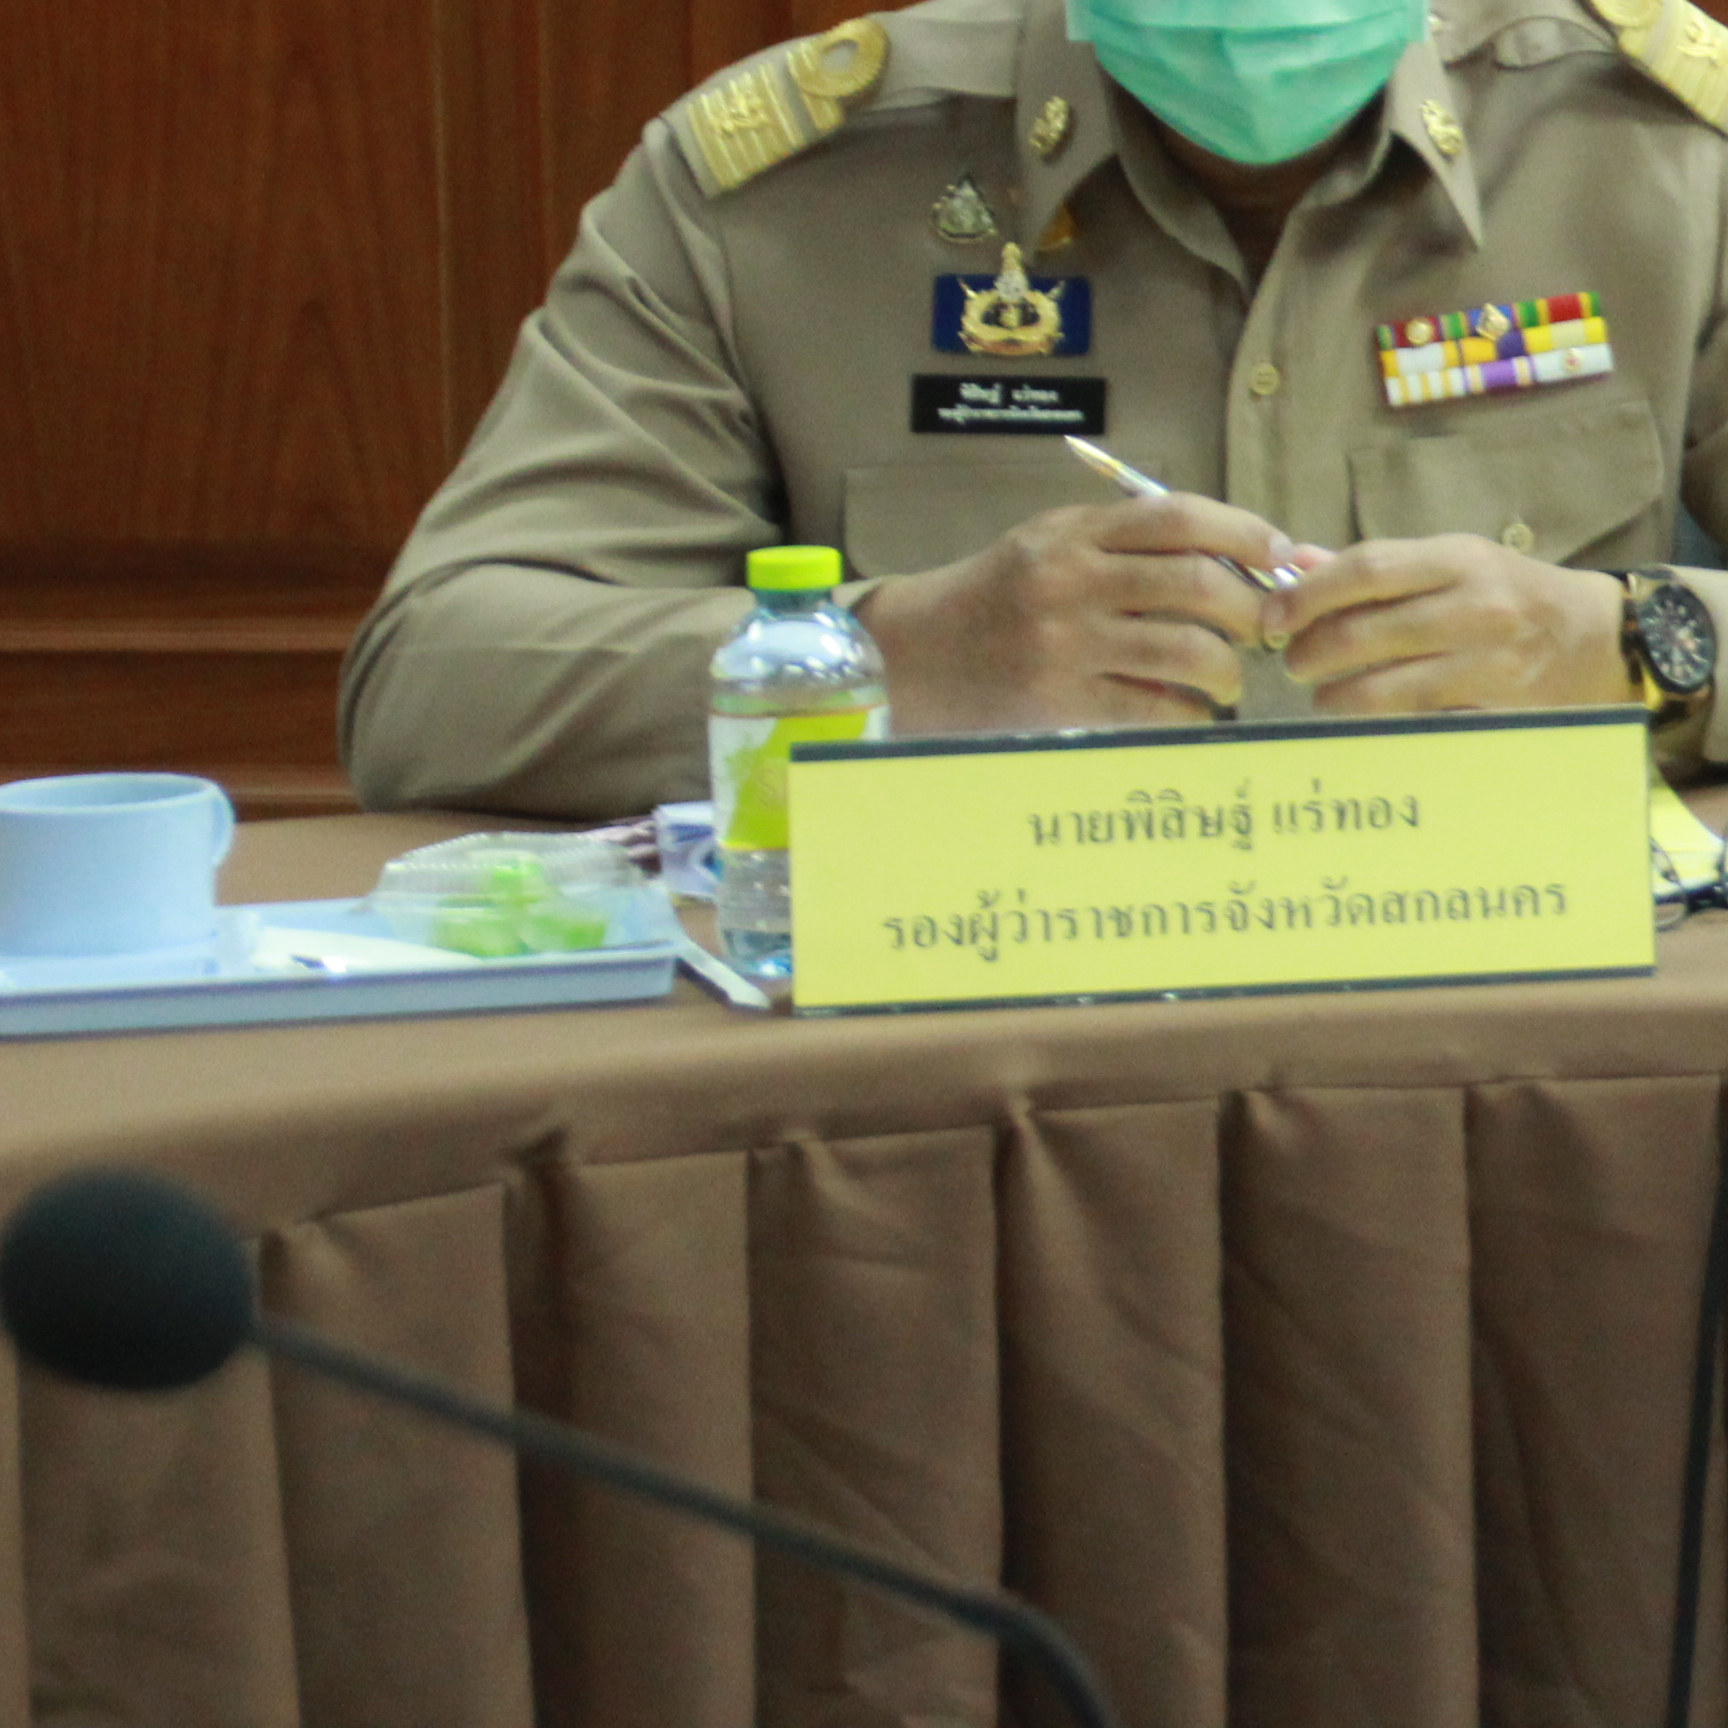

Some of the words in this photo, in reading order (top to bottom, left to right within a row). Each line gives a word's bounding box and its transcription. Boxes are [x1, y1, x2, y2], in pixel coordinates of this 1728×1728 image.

[1271, 777, 1421, 835] แร่ทอง
[882, 876, 1569, 964] รองผู้ว่าราชการจังหวัดสกลนคร
